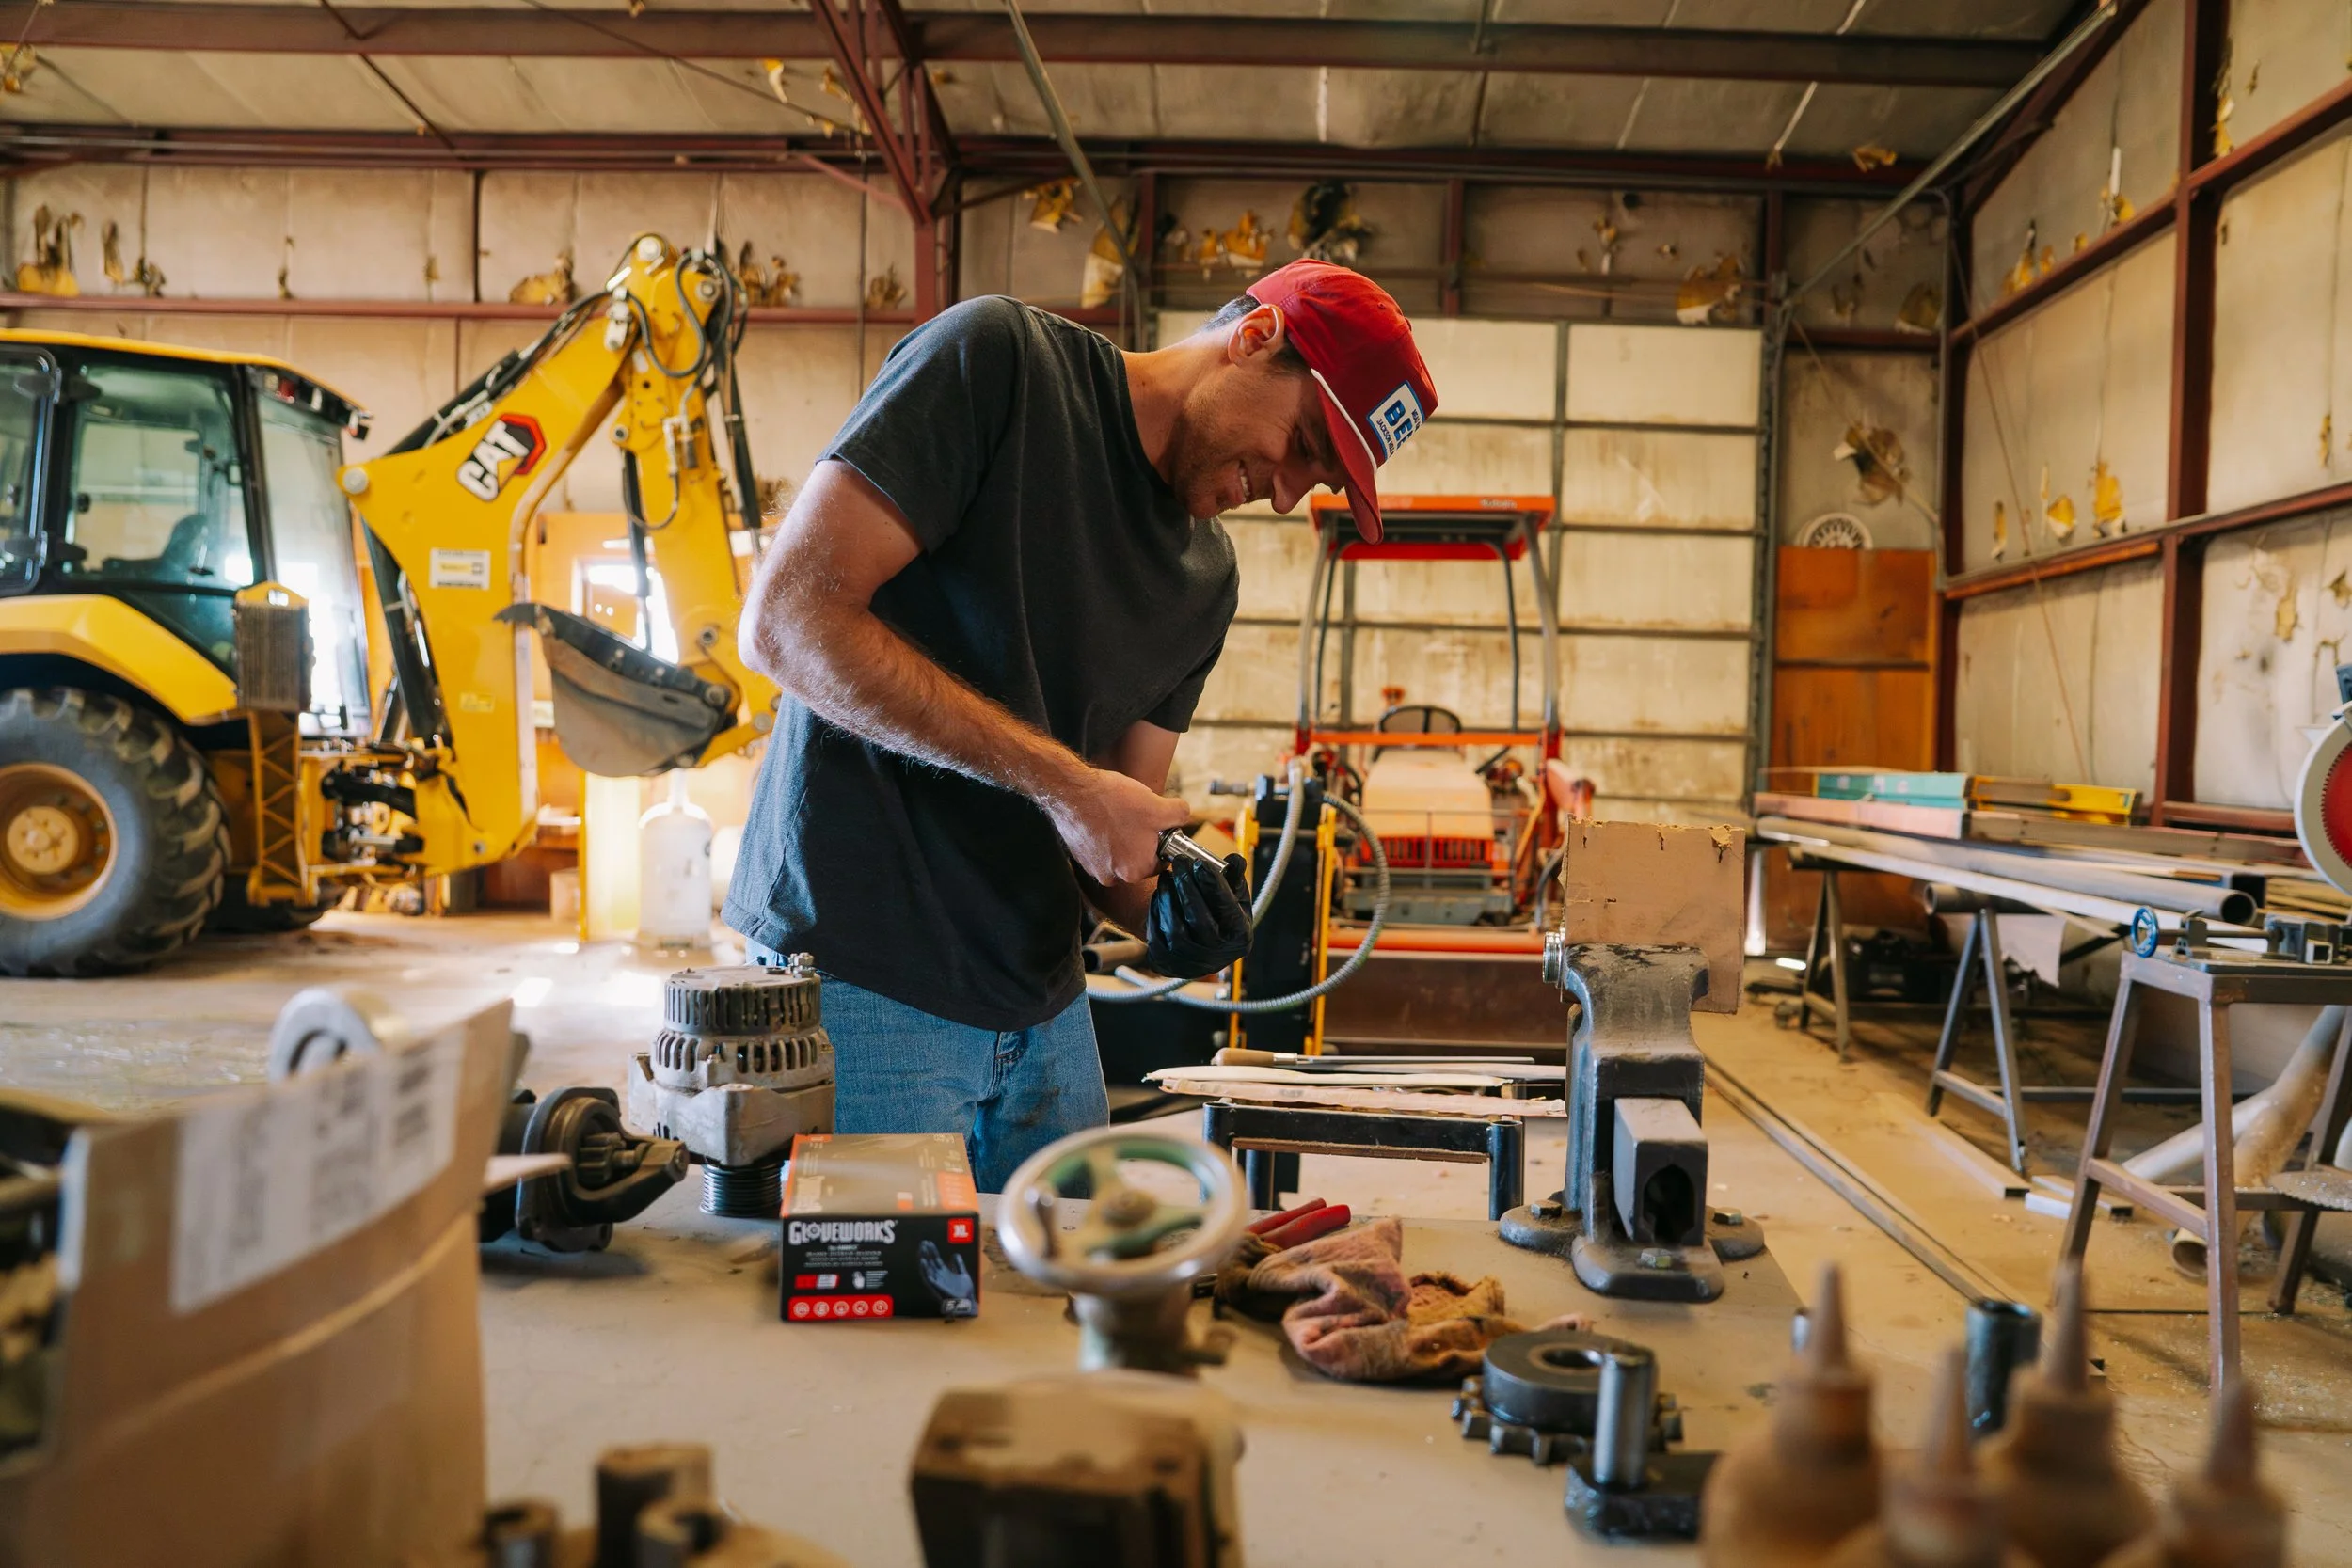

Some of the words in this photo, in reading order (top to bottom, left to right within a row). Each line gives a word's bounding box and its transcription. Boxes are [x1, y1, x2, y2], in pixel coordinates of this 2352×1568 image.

[1376, 419, 1391, 443] JACKSON
[457, 420, 530, 501] CAT
[788, 1219, 896, 1245] GLOVEWORKS
[953, 1224, 969, 1238] XL
